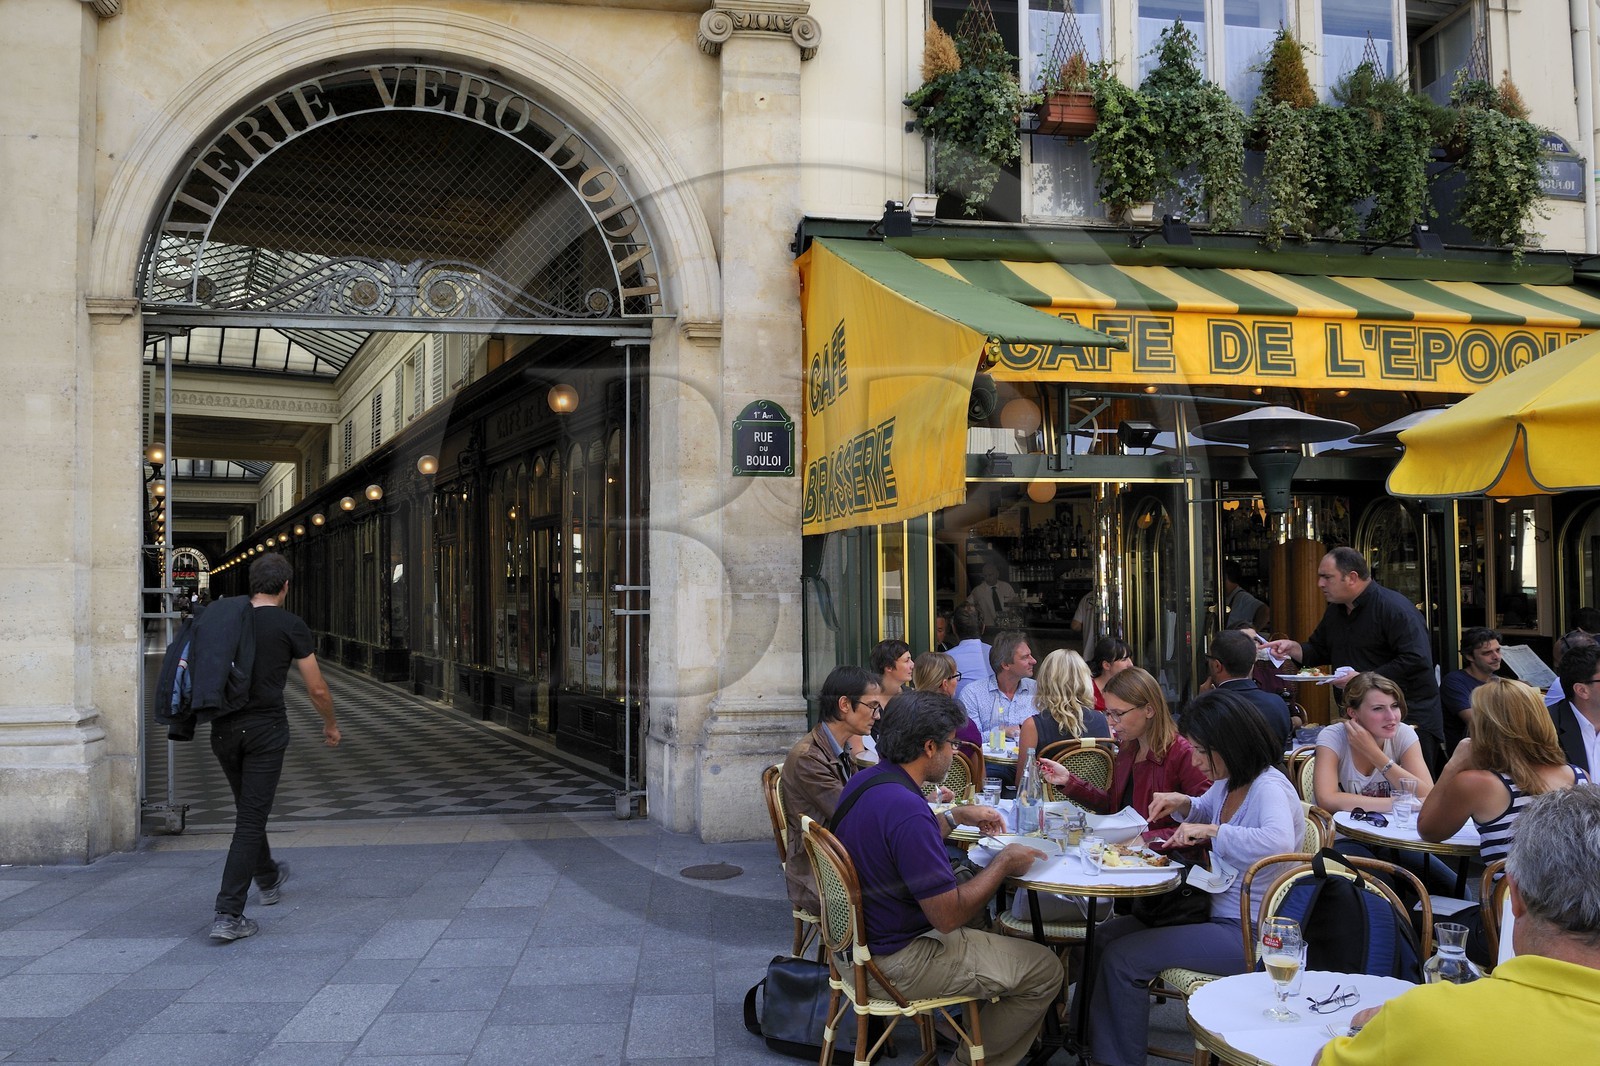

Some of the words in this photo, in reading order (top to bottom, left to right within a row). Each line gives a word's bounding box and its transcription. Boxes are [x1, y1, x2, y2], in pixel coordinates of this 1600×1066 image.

[154, 77, 338, 288] GALERIE
[364, 66, 531, 134] VERO
[540, 126, 663, 306] DODAT
[809, 317, 849, 417] CAFE
[1207, 318, 1297, 377] DE
[1325, 323, 1591, 385] L'EPOQ
[746, 455, 781, 466] BOULOI
[753, 431, 774, 443] RUE
[801, 415, 899, 526] BRASSERIE
